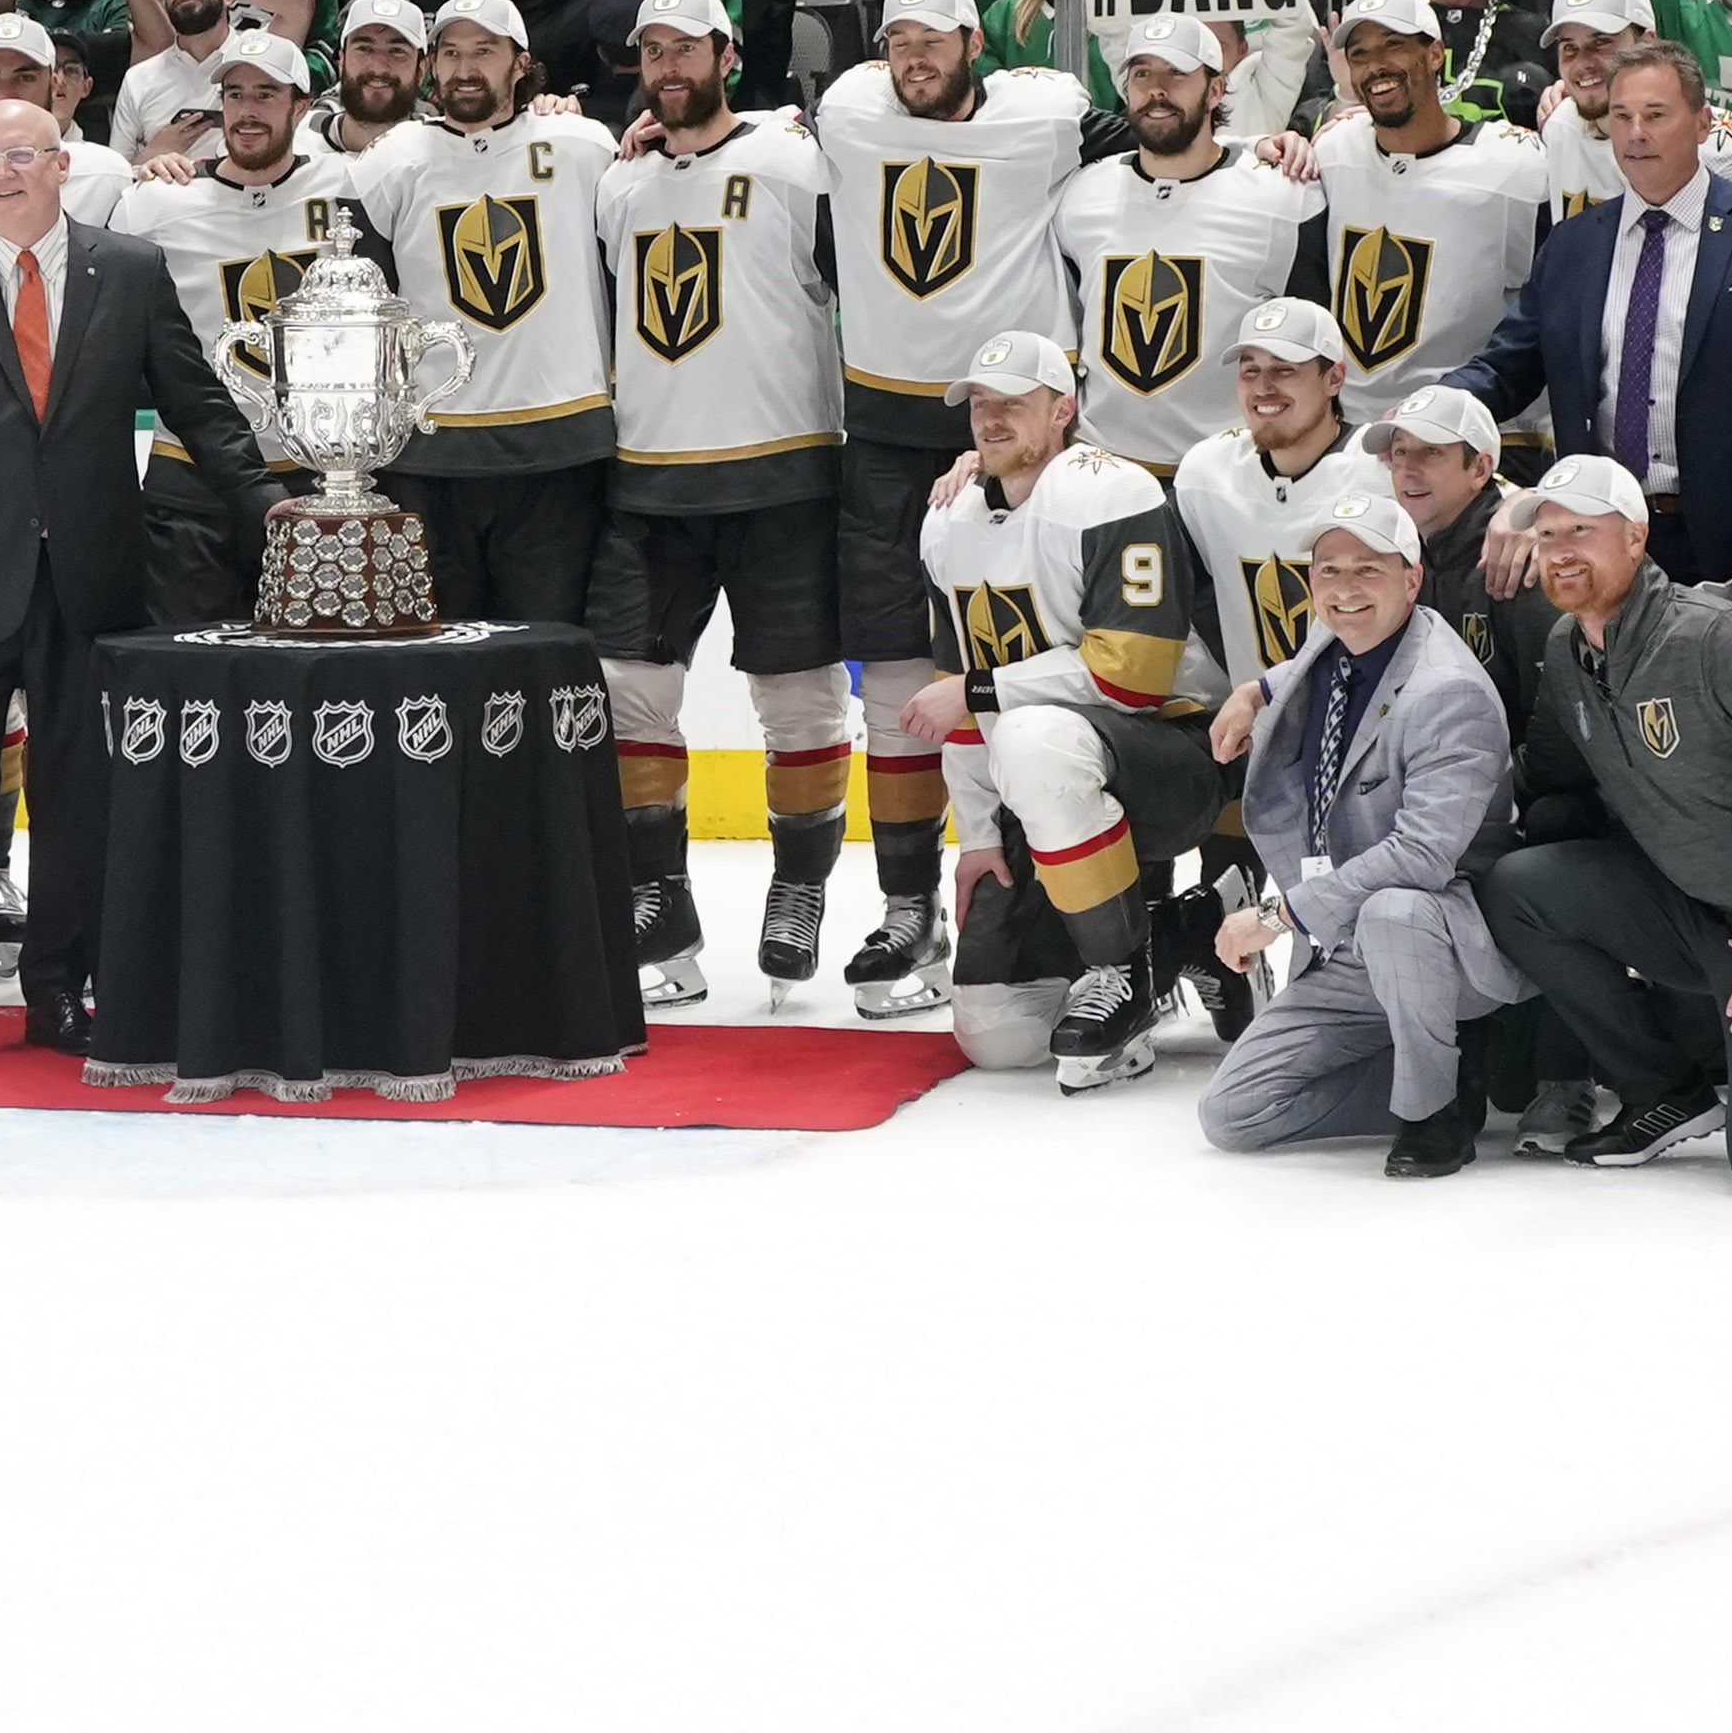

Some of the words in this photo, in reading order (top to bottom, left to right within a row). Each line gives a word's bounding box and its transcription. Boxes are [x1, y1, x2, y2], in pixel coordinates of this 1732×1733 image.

[527, 141, 555, 184] C
[304, 197, 330, 243] A
[720, 173, 752, 222] A
[1121, 542, 1164, 607] 9
